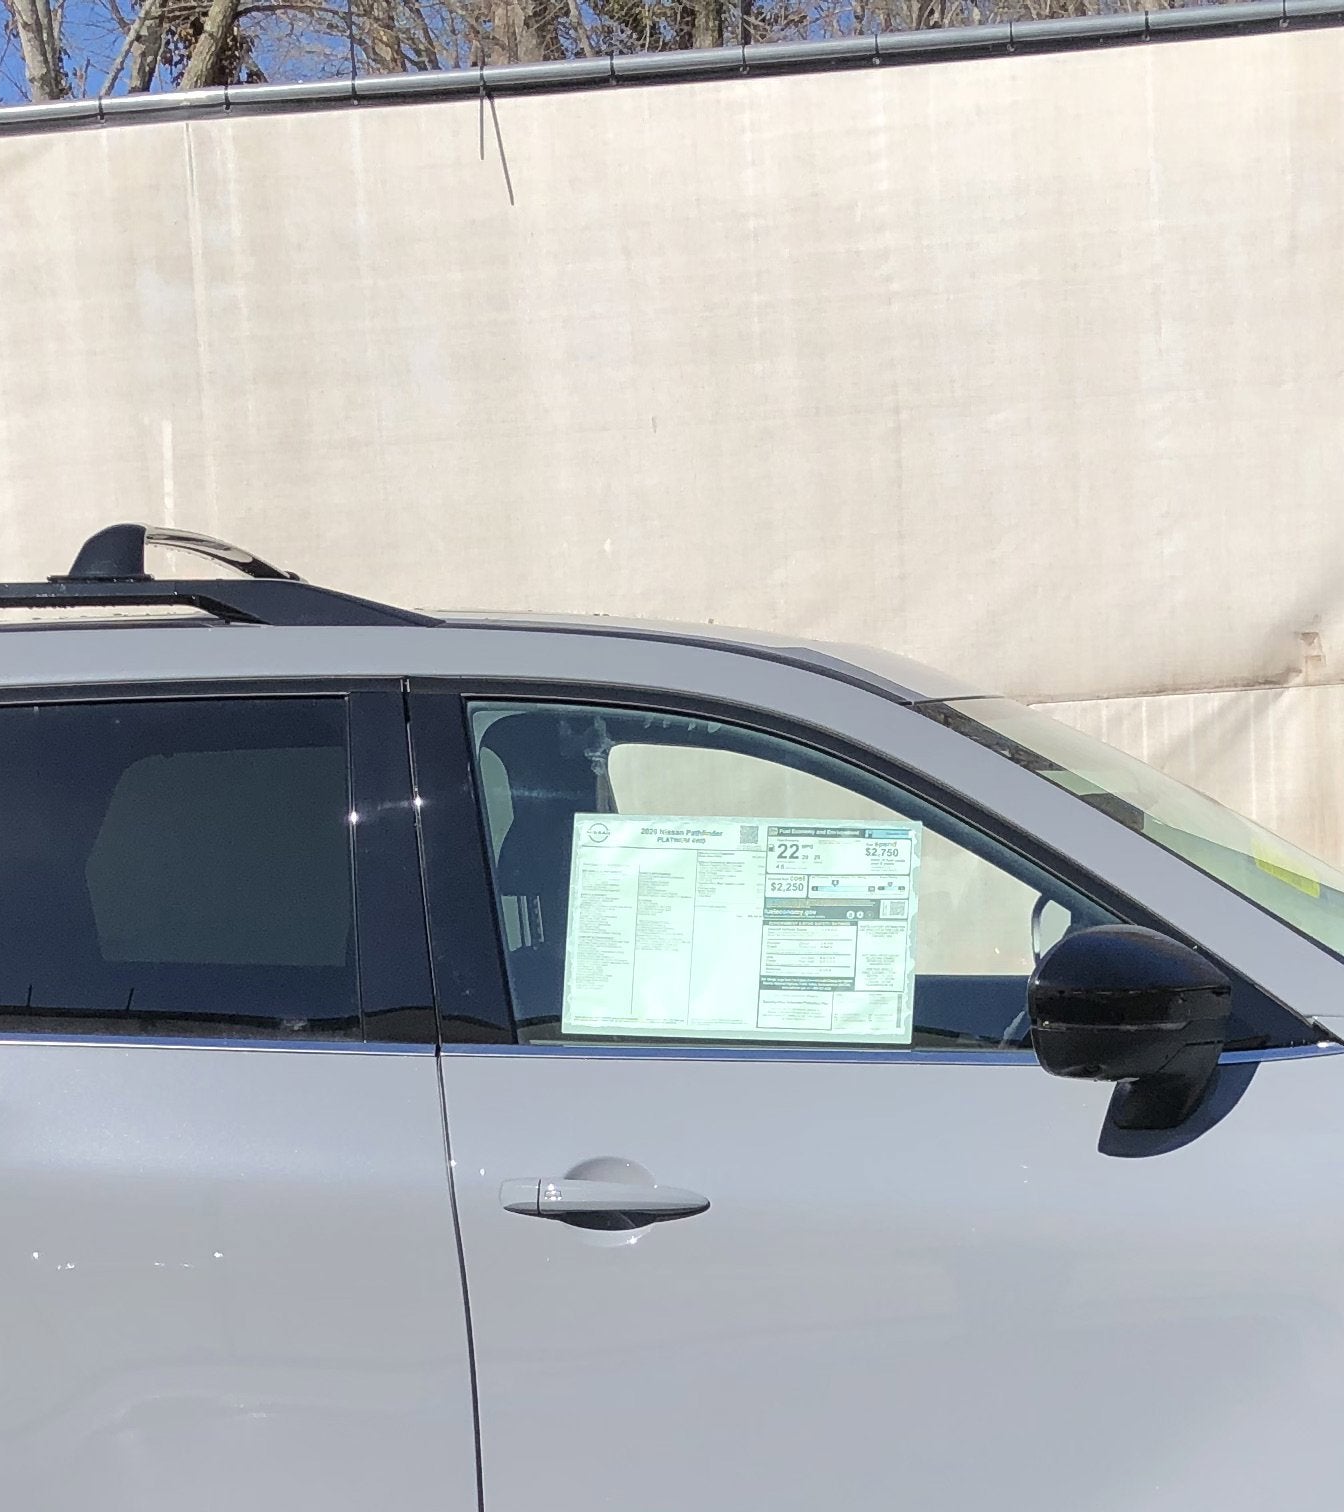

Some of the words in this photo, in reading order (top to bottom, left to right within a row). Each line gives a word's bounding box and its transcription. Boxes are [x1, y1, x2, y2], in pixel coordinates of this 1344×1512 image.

[776, 843, 800, 860] 22
[865, 847, 899, 858] $2,750
[770, 881, 804, 893] $2,250
